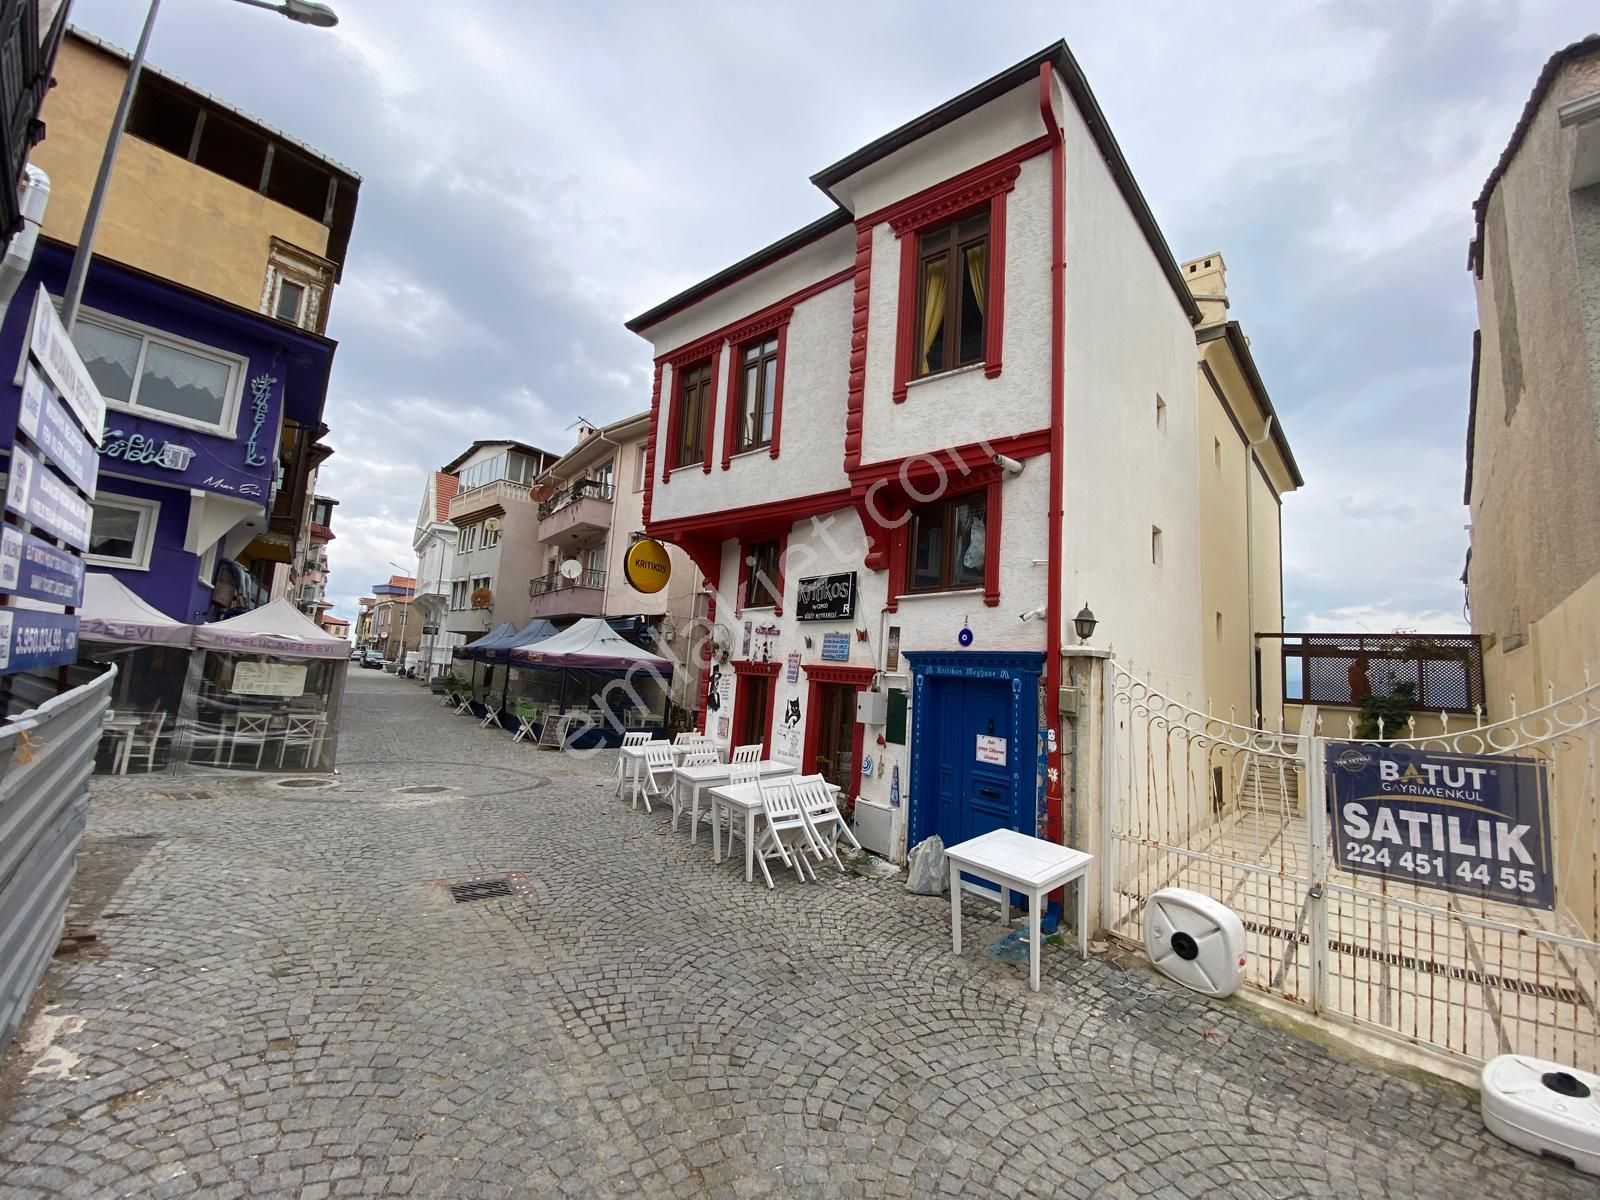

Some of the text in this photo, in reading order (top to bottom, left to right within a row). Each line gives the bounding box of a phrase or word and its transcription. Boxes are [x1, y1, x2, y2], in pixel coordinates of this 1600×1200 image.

[79, 620, 116, 636] EZE
[1379, 759, 1487, 790] BATUT
[1342, 802, 1536, 866] SATILIK
[1346, 842, 1536, 893] 224 451 44 55
